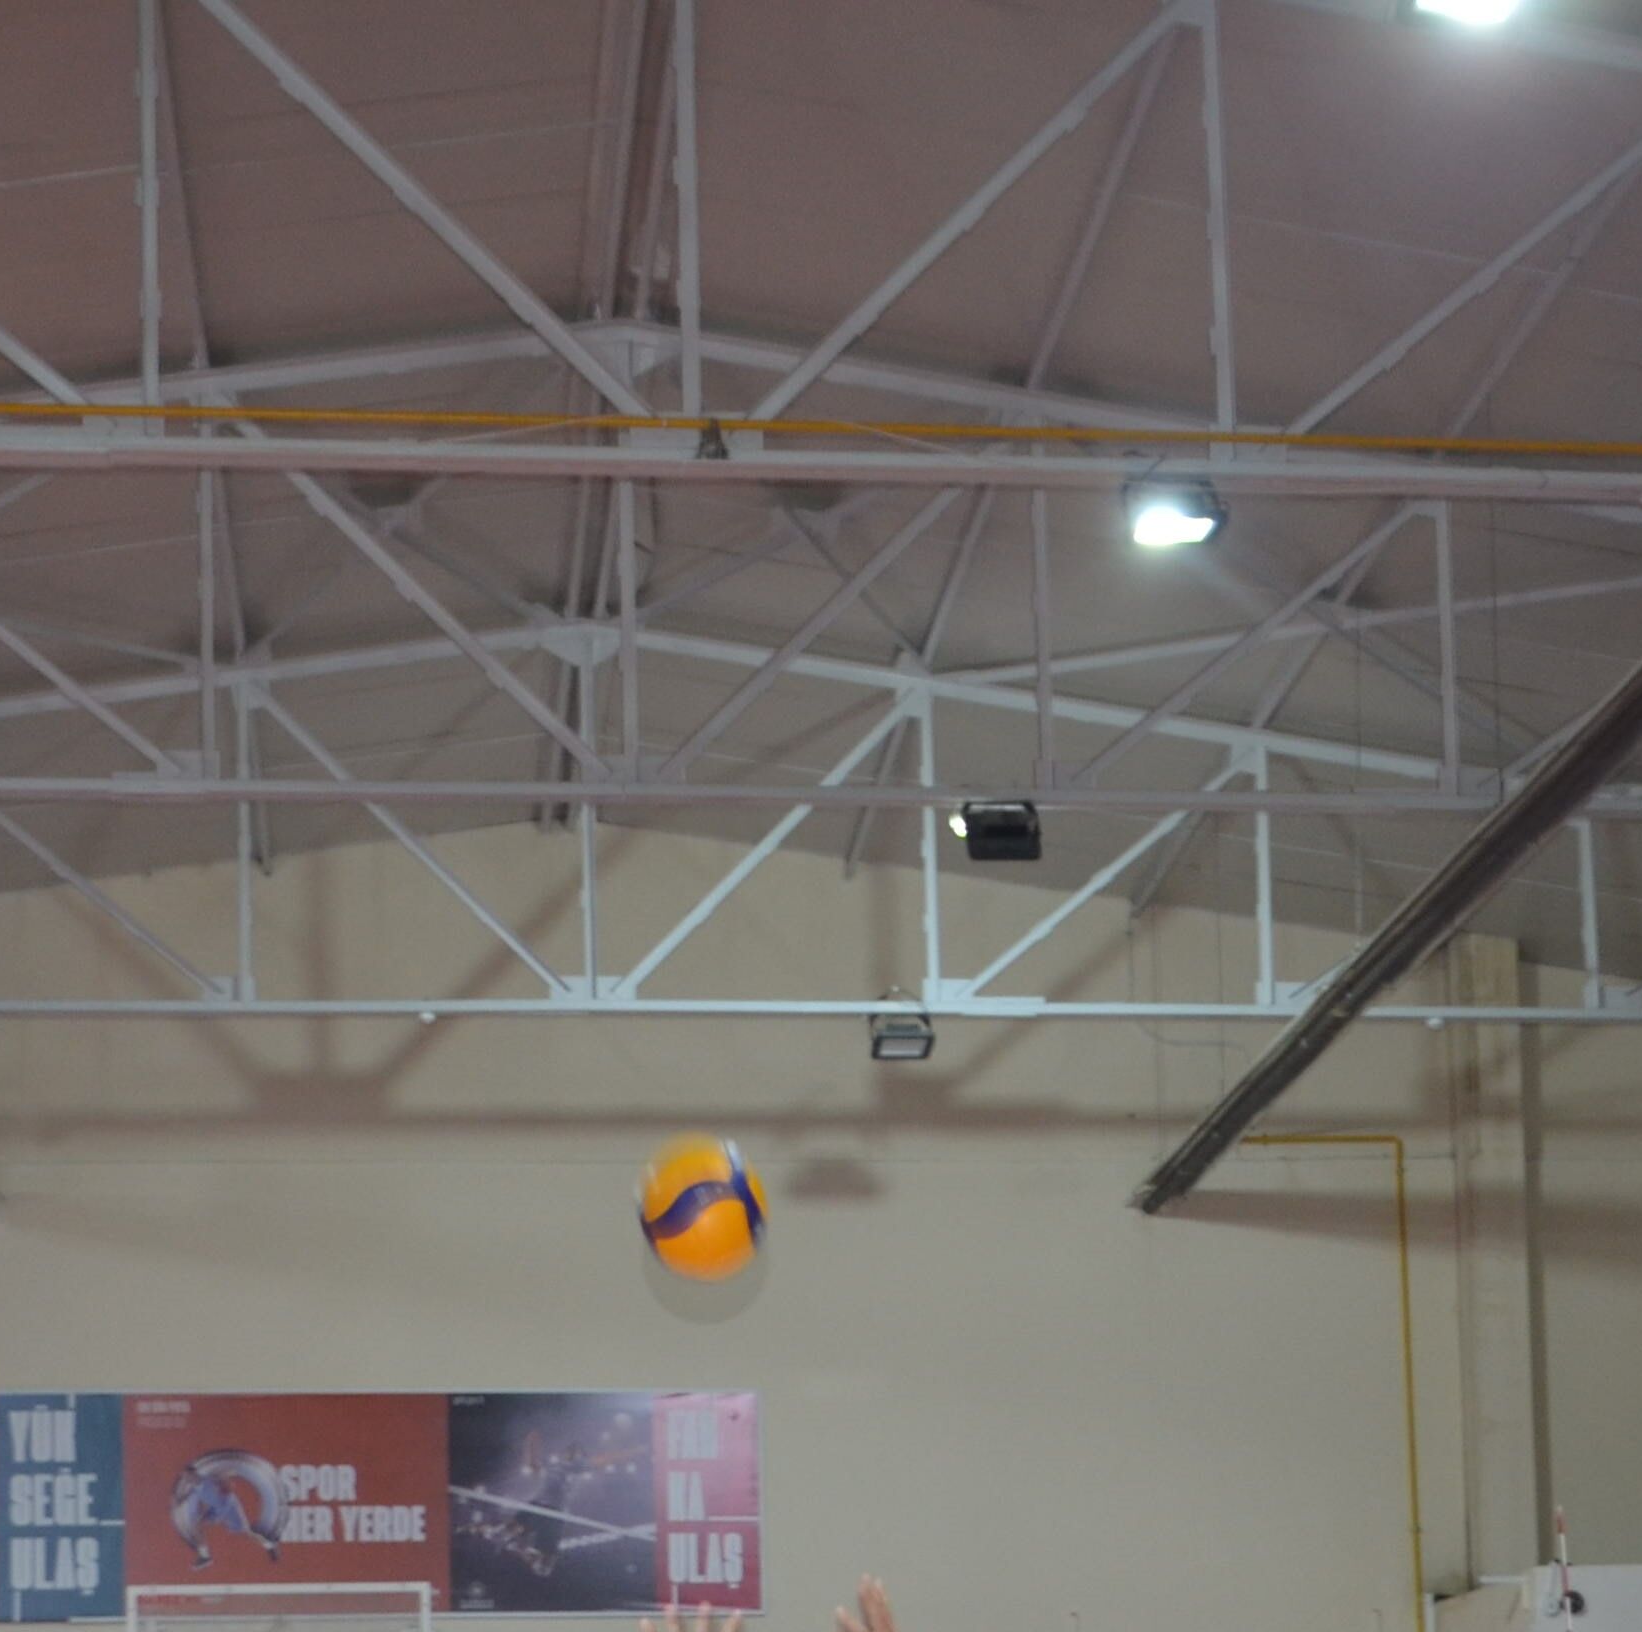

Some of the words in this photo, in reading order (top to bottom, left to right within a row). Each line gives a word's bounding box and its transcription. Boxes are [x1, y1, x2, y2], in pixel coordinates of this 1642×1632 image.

[278, 1464, 358, 1501] SPOR
[339, 1505, 427, 1542] YERDE
[9, 1537, 100, 1596] ULAŞ
